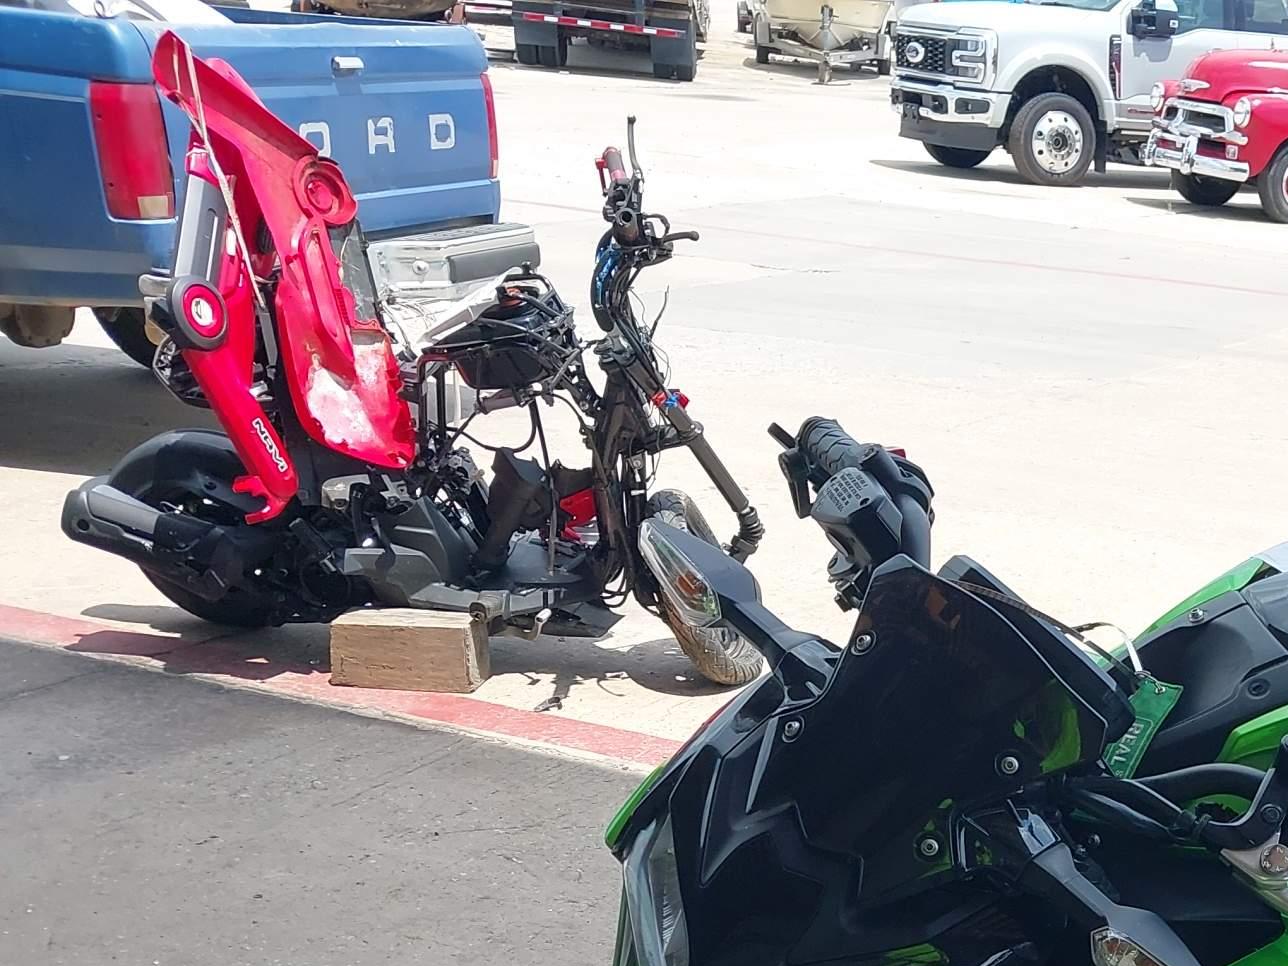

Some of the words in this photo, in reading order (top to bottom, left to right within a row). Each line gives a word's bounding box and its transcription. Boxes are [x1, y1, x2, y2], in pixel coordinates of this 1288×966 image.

[299, 113, 455, 158] ORD
[252, 417, 288, 472] NAVI
[1109, 722, 1145, 766] REAL
